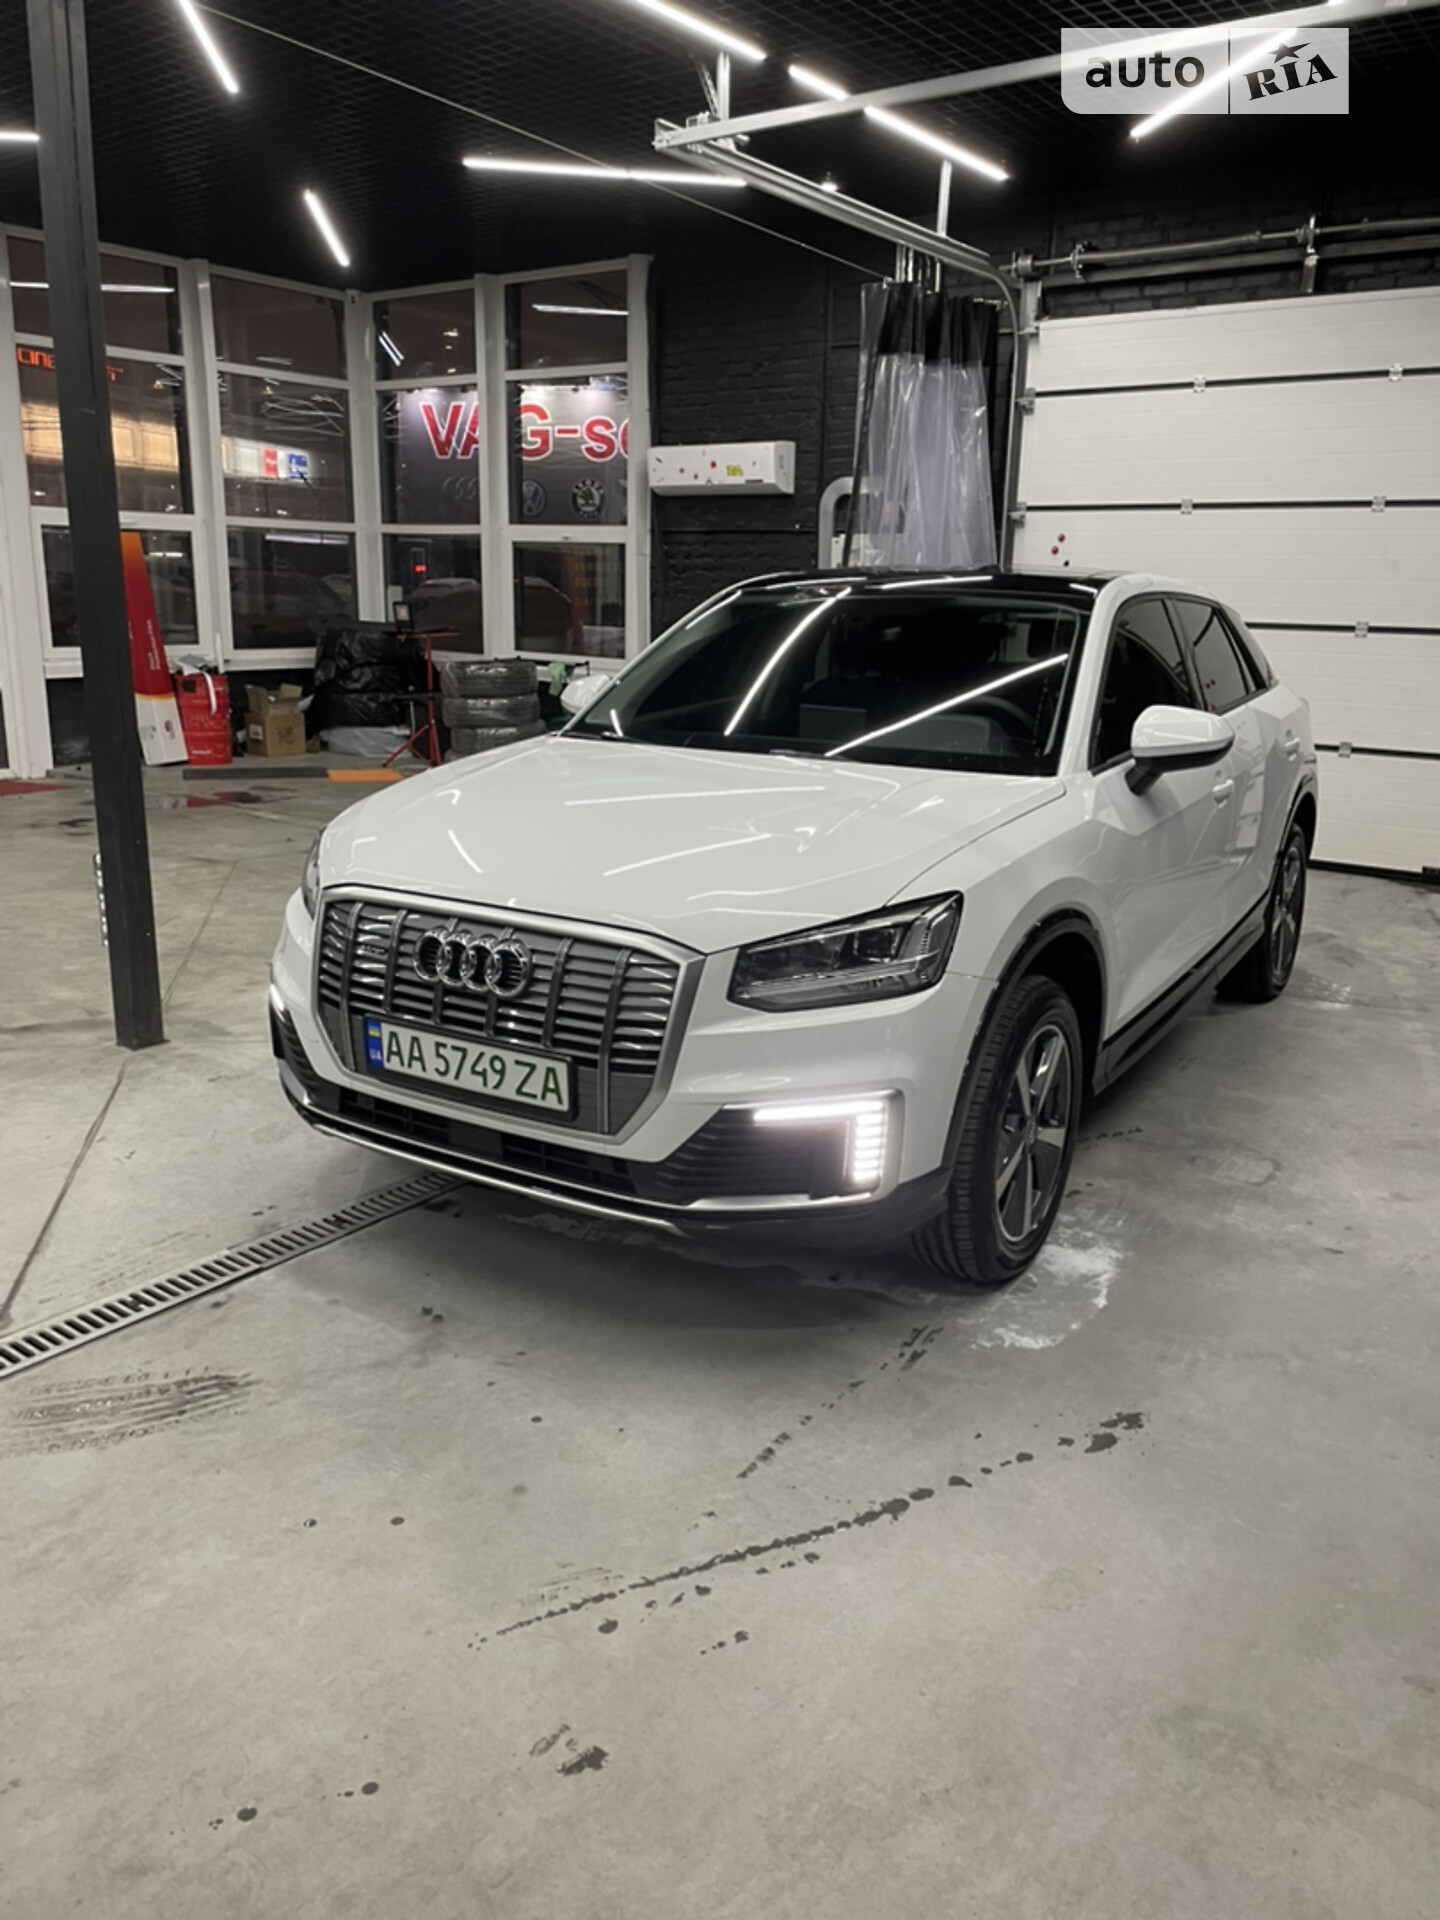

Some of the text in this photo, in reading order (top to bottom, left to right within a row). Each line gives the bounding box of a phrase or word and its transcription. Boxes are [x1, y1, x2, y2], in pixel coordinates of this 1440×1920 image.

[419, 402, 629, 462] VG-s
[386, 1031, 564, 1105] AA 5749 ZA
